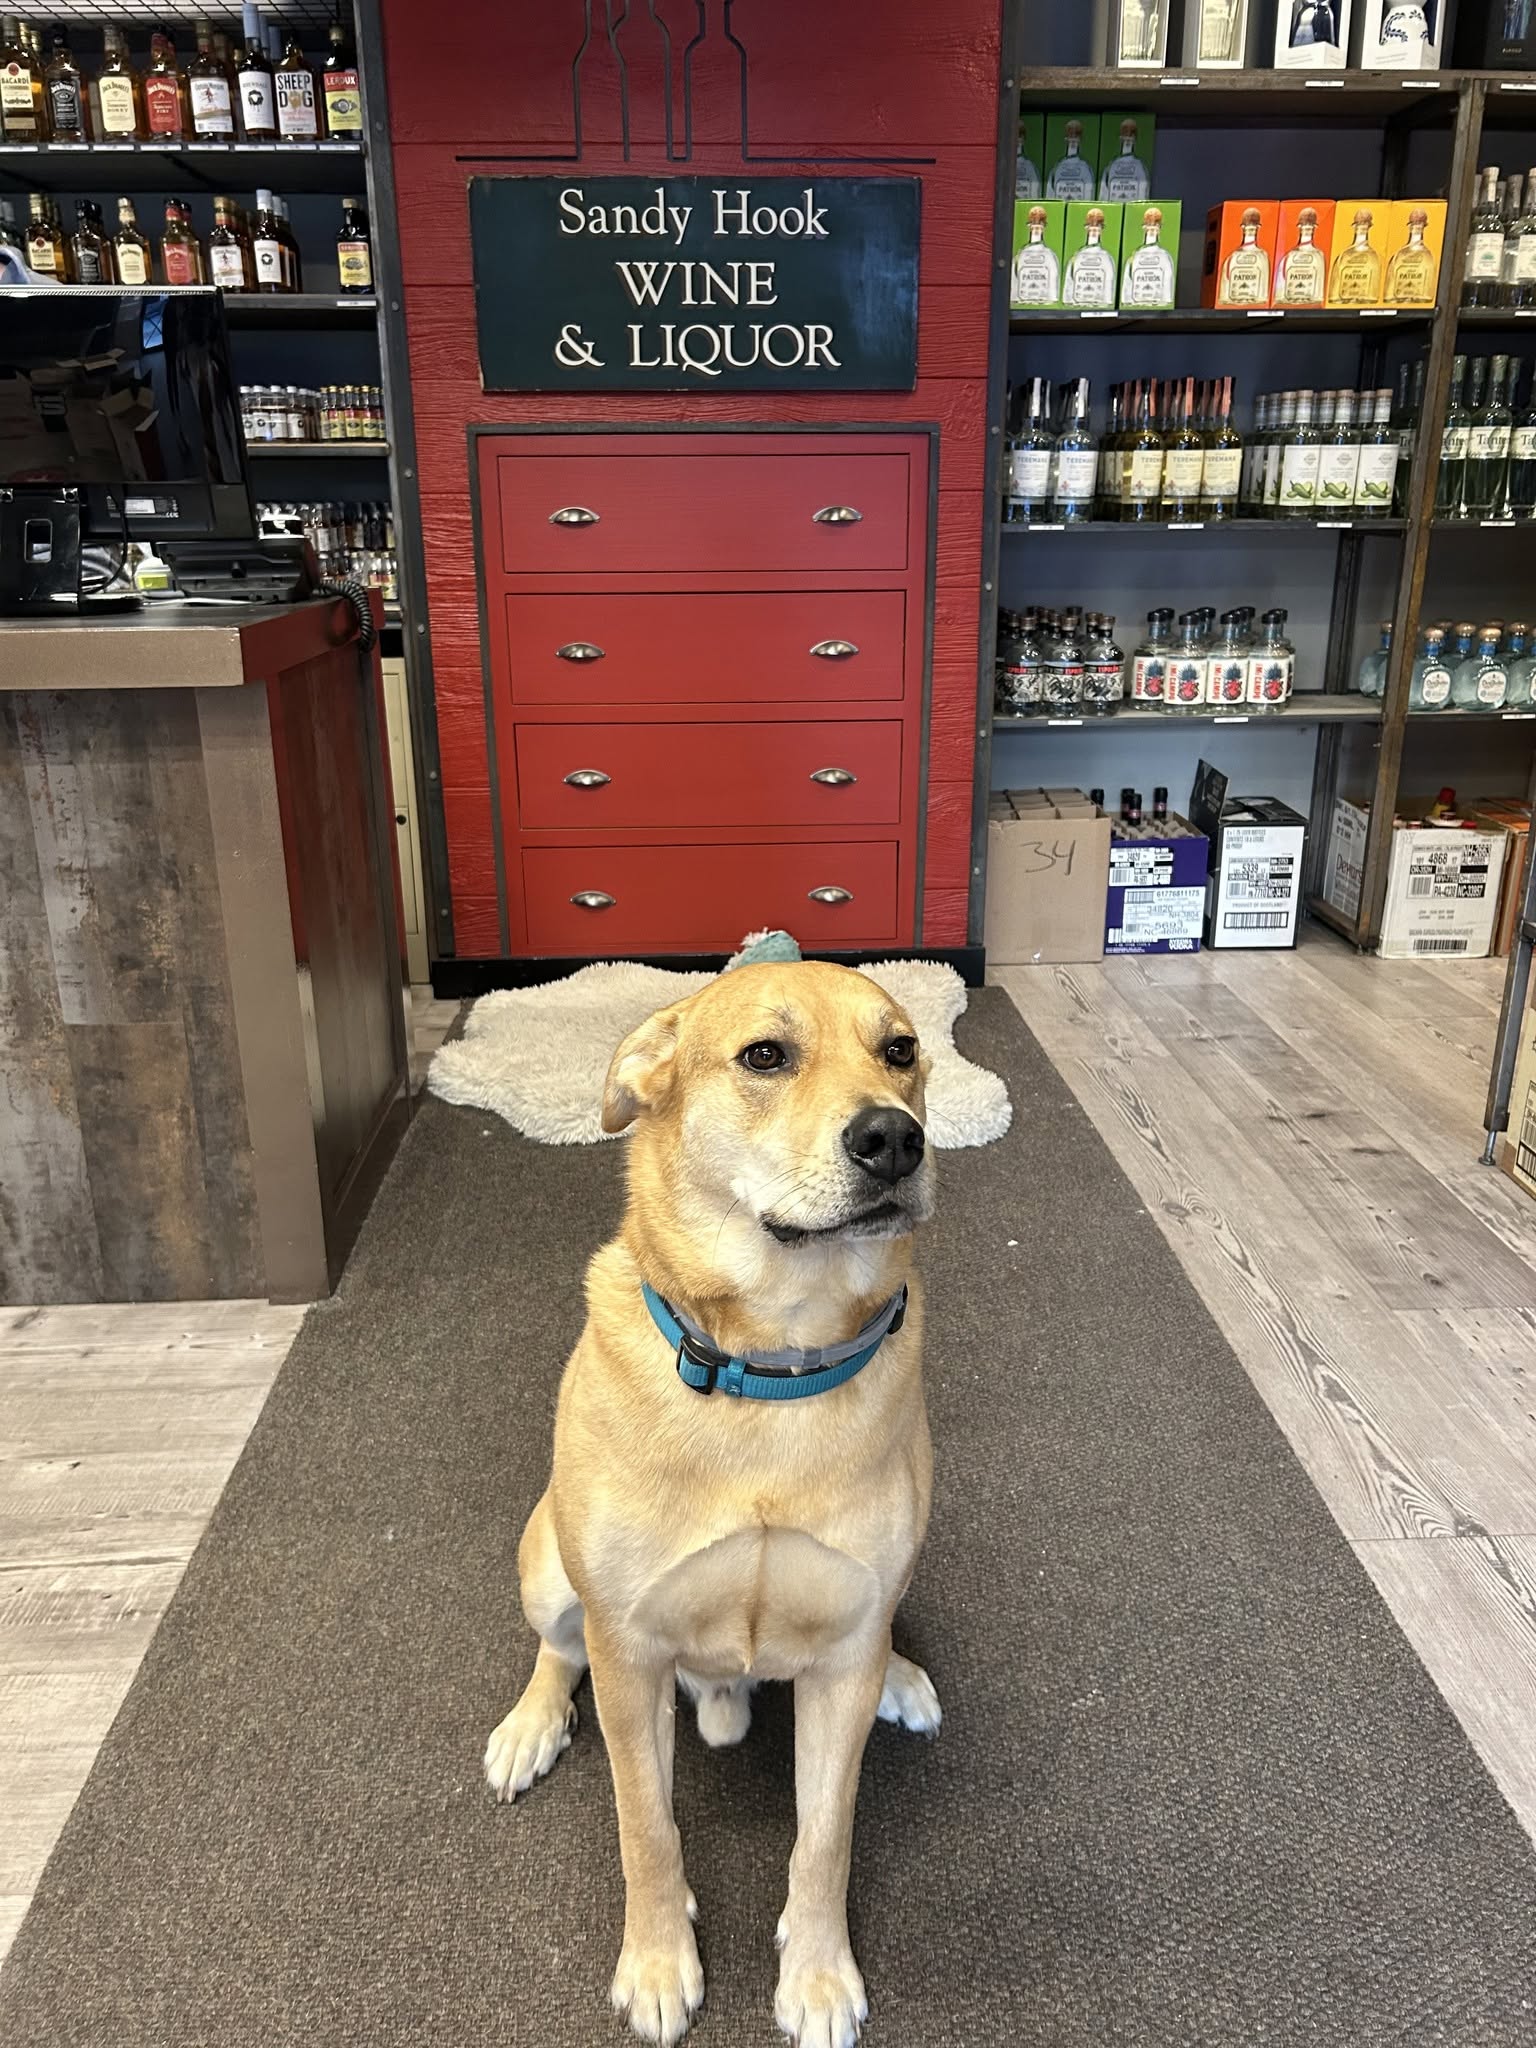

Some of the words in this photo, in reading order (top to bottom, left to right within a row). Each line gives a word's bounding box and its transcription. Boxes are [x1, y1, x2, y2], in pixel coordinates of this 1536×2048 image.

[277, 74, 311, 90] SHEEP
[327, 76, 356, 86] LEROUX
[559, 187, 693, 245] Sandy
[711, 188, 829, 236] Hook
[616, 262, 778, 306] WINE
[554, 324, 606, 367] &
[627, 324, 842, 376] LIQUOR
[1018, 840, 1076, 876] 34
[1428, 852, 1448, 865] 4868
